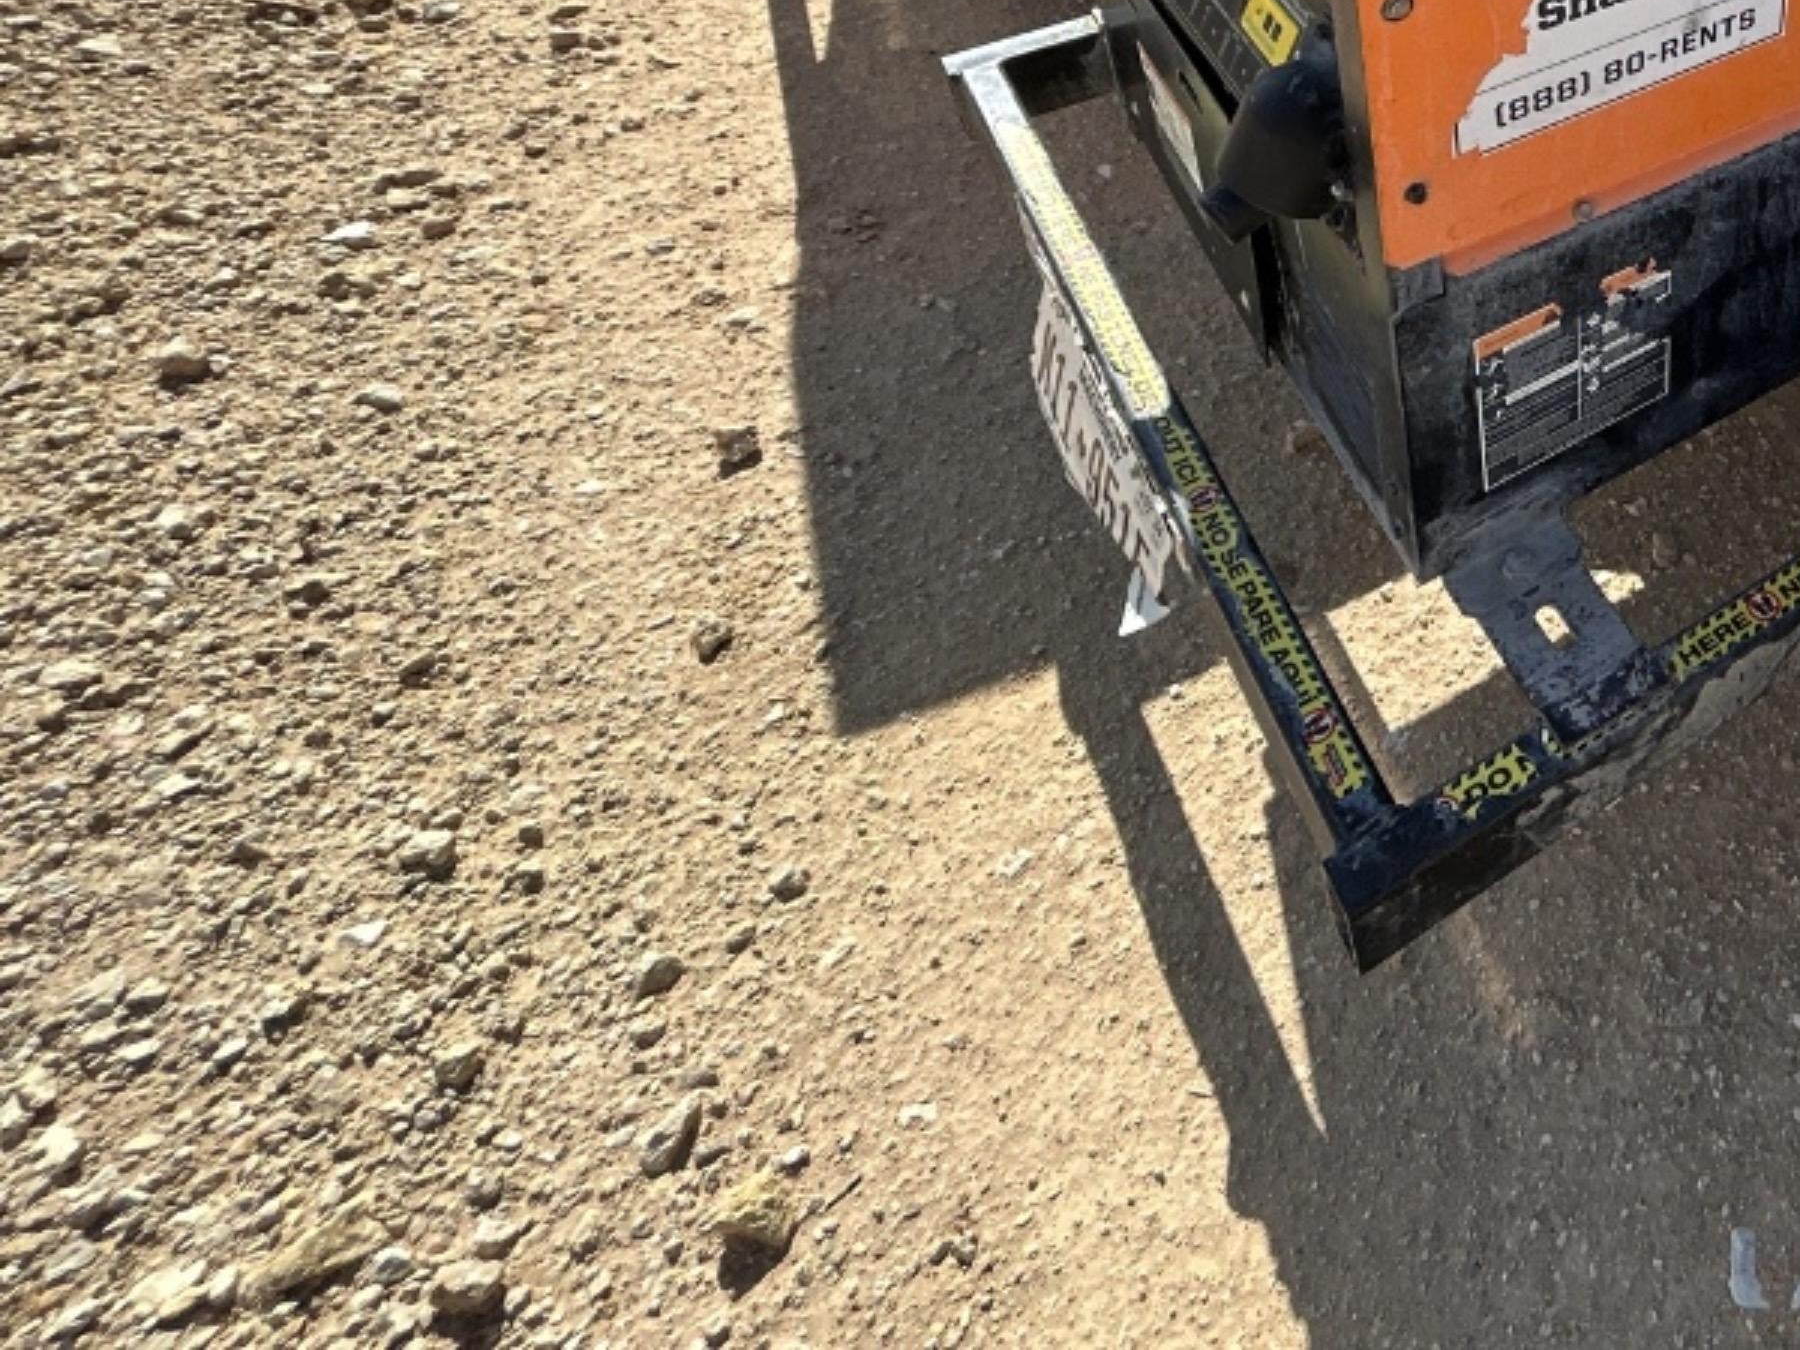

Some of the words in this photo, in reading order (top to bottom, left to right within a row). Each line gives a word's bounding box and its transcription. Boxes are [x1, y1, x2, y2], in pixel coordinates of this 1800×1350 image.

[1494, 70, 1591, 128] (888)
[1603, 7, 1758, 85] 80-RENTS
[1202, 511, 1231, 547] NO
[1219, 549, 1249, 581] SE
[1235, 580, 1282, 646] PARE
[1677, 609, 1753, 663] HERE
